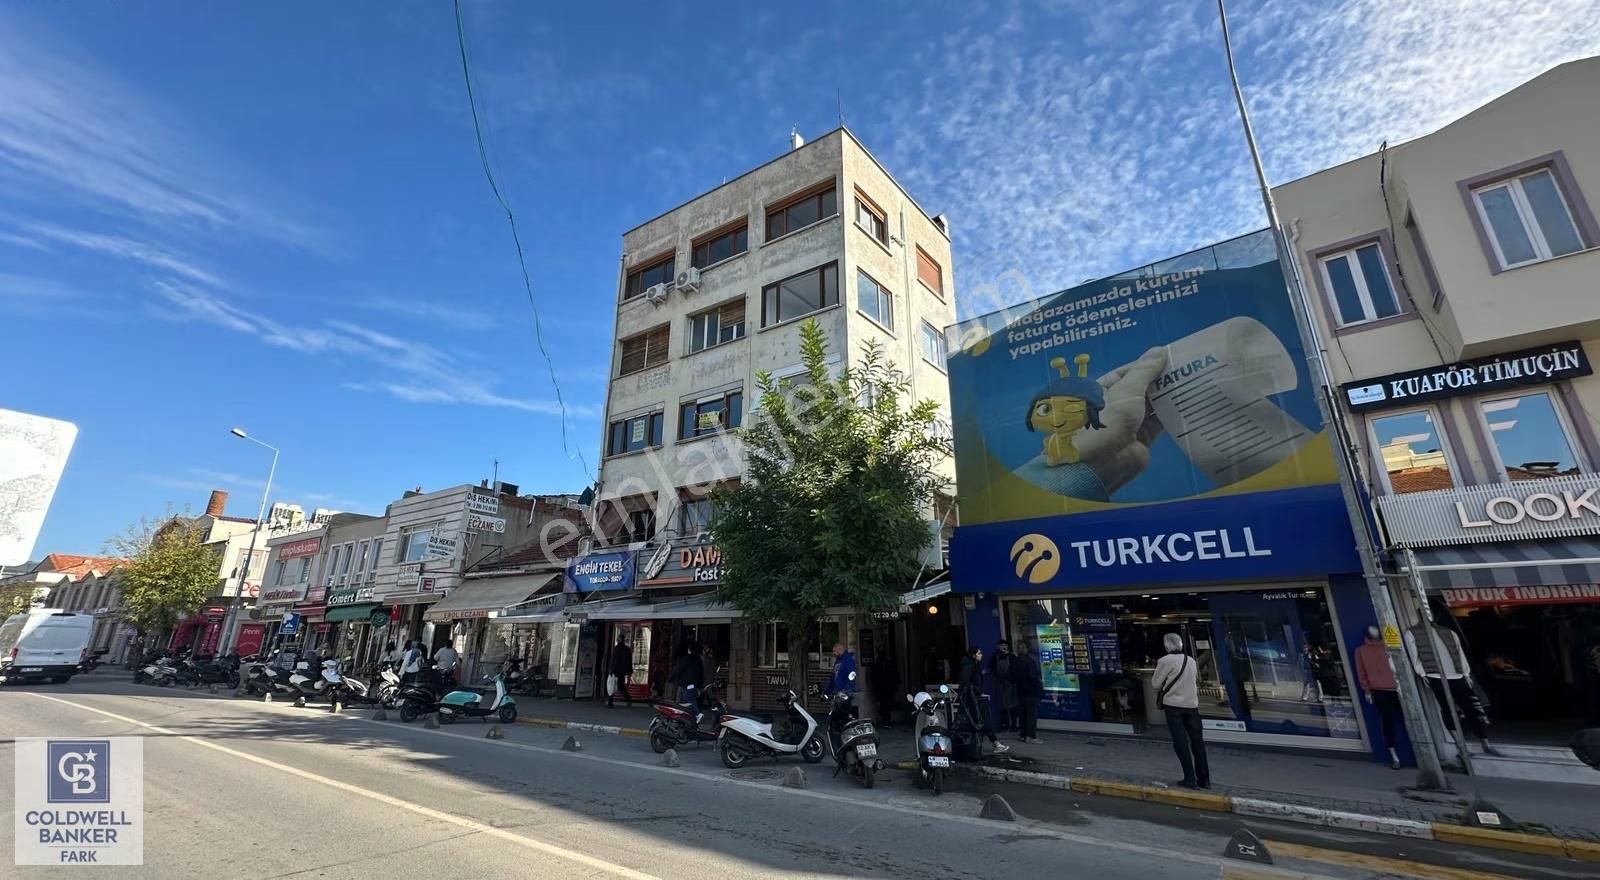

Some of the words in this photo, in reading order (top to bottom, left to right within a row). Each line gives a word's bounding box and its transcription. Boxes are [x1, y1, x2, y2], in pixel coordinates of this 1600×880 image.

[1136, 266, 1204, 293] kurum
[1008, 318, 1062, 343] fatura
[1065, 280, 1199, 327] ödemelerinizi
[1009, 316, 1137, 360] yapabilirsiniz.
[1156, 354, 1219, 390] FATURA
[1390, 366, 1477, 399] KUAFÖR
[1479, 348, 1579, 384] TİMUÇİN
[468, 519, 494, 531] ECZANE
[1071, 526, 1272, 568] TURKCELL
[575, 561, 598, 576] ENGİN
[600, 560, 623, 573] TEKEL
[695, 567, 718, 581] Fast
[423, 580, 432, 590] E
[809, 684, 819, 694] ER
